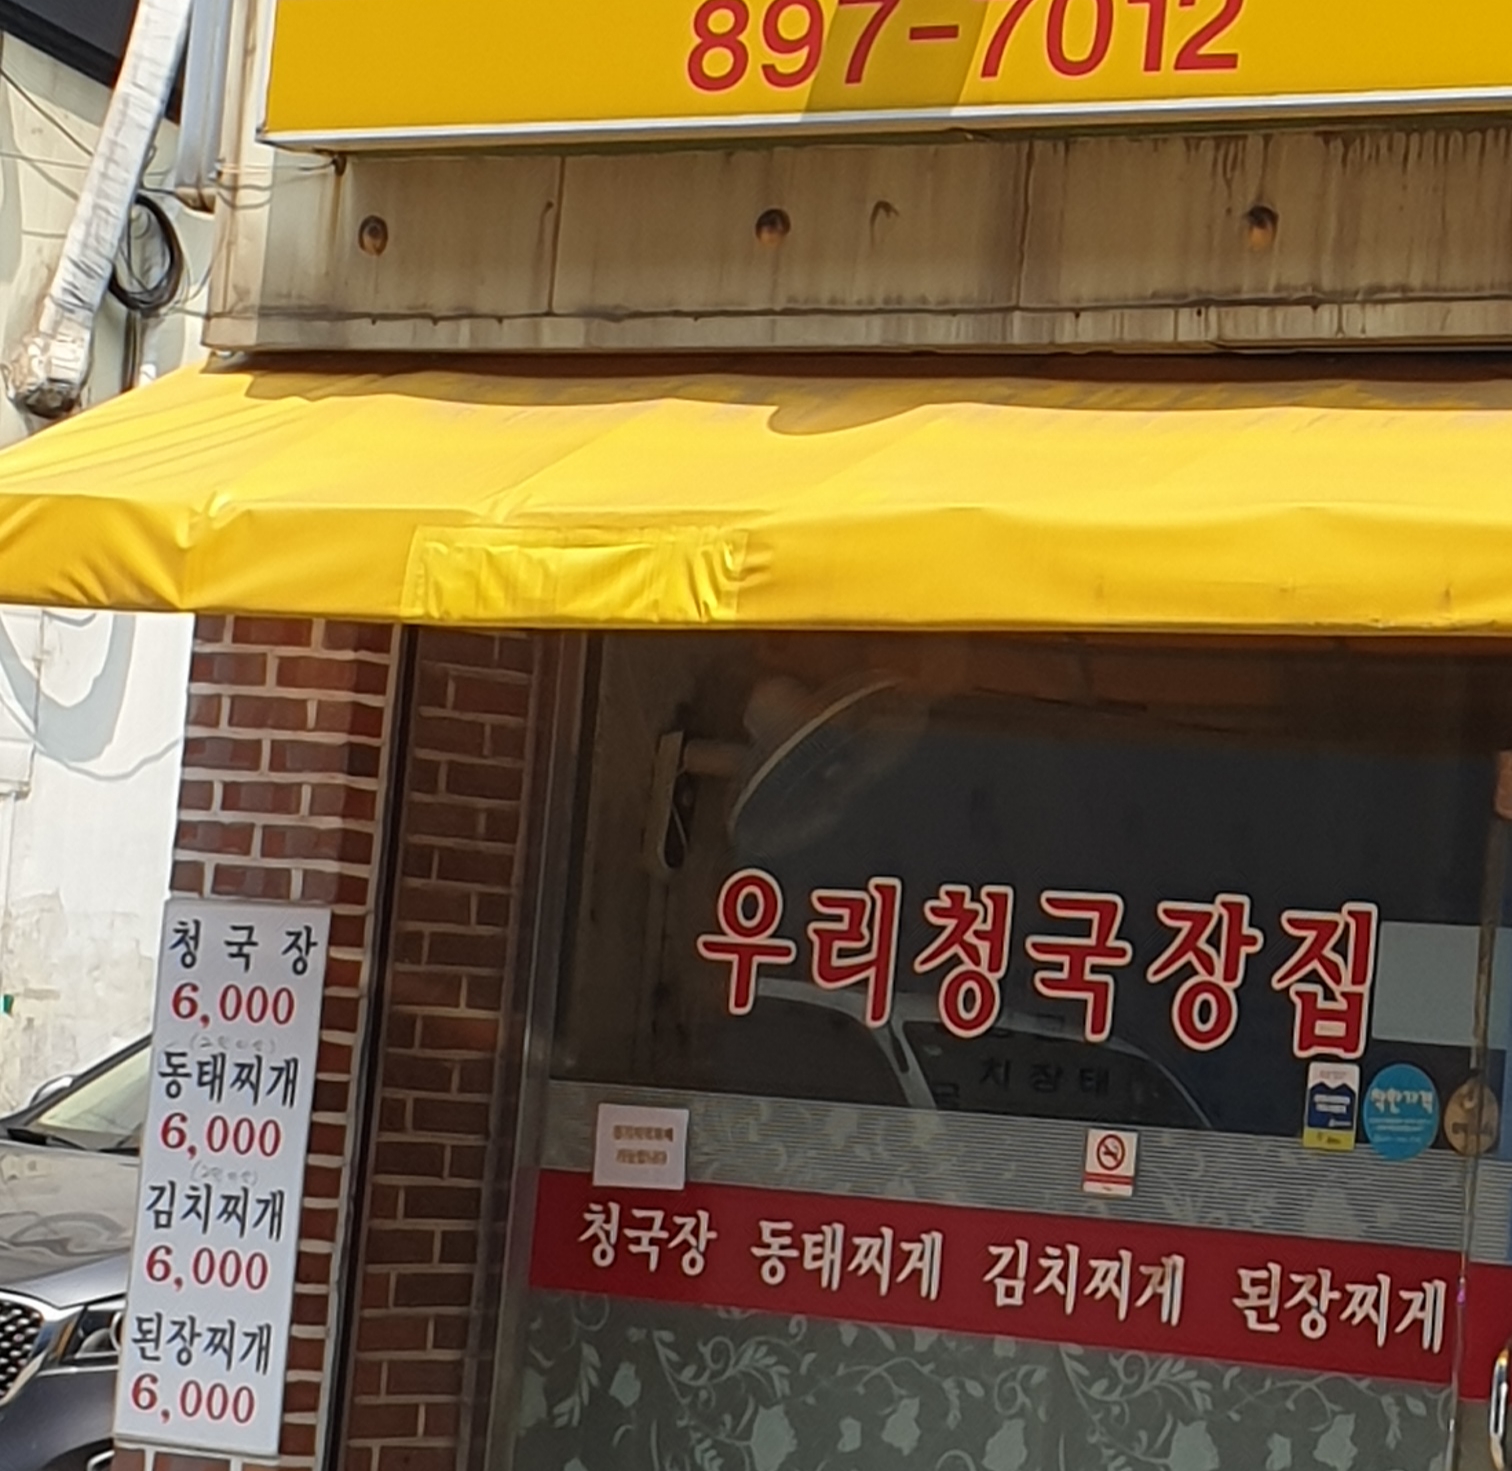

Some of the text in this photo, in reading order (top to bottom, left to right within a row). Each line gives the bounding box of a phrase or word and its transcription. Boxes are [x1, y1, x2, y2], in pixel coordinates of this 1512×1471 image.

[696, 867, 1378, 1058] 우리청국장집
[171, 981, 296, 1028] 6,000
[157, 1050, 300, 1109] 동태찌개
[159, 1112, 282, 1160] 6,000
[146, 1181, 286, 1242] 김치찌개
[577, 1202, 718, 1276] 청국장
[144, 1245, 270, 1292] 6,000
[131, 1313, 273, 1376] 된장찌개
[130, 1373, 256, 1424] 6,000
